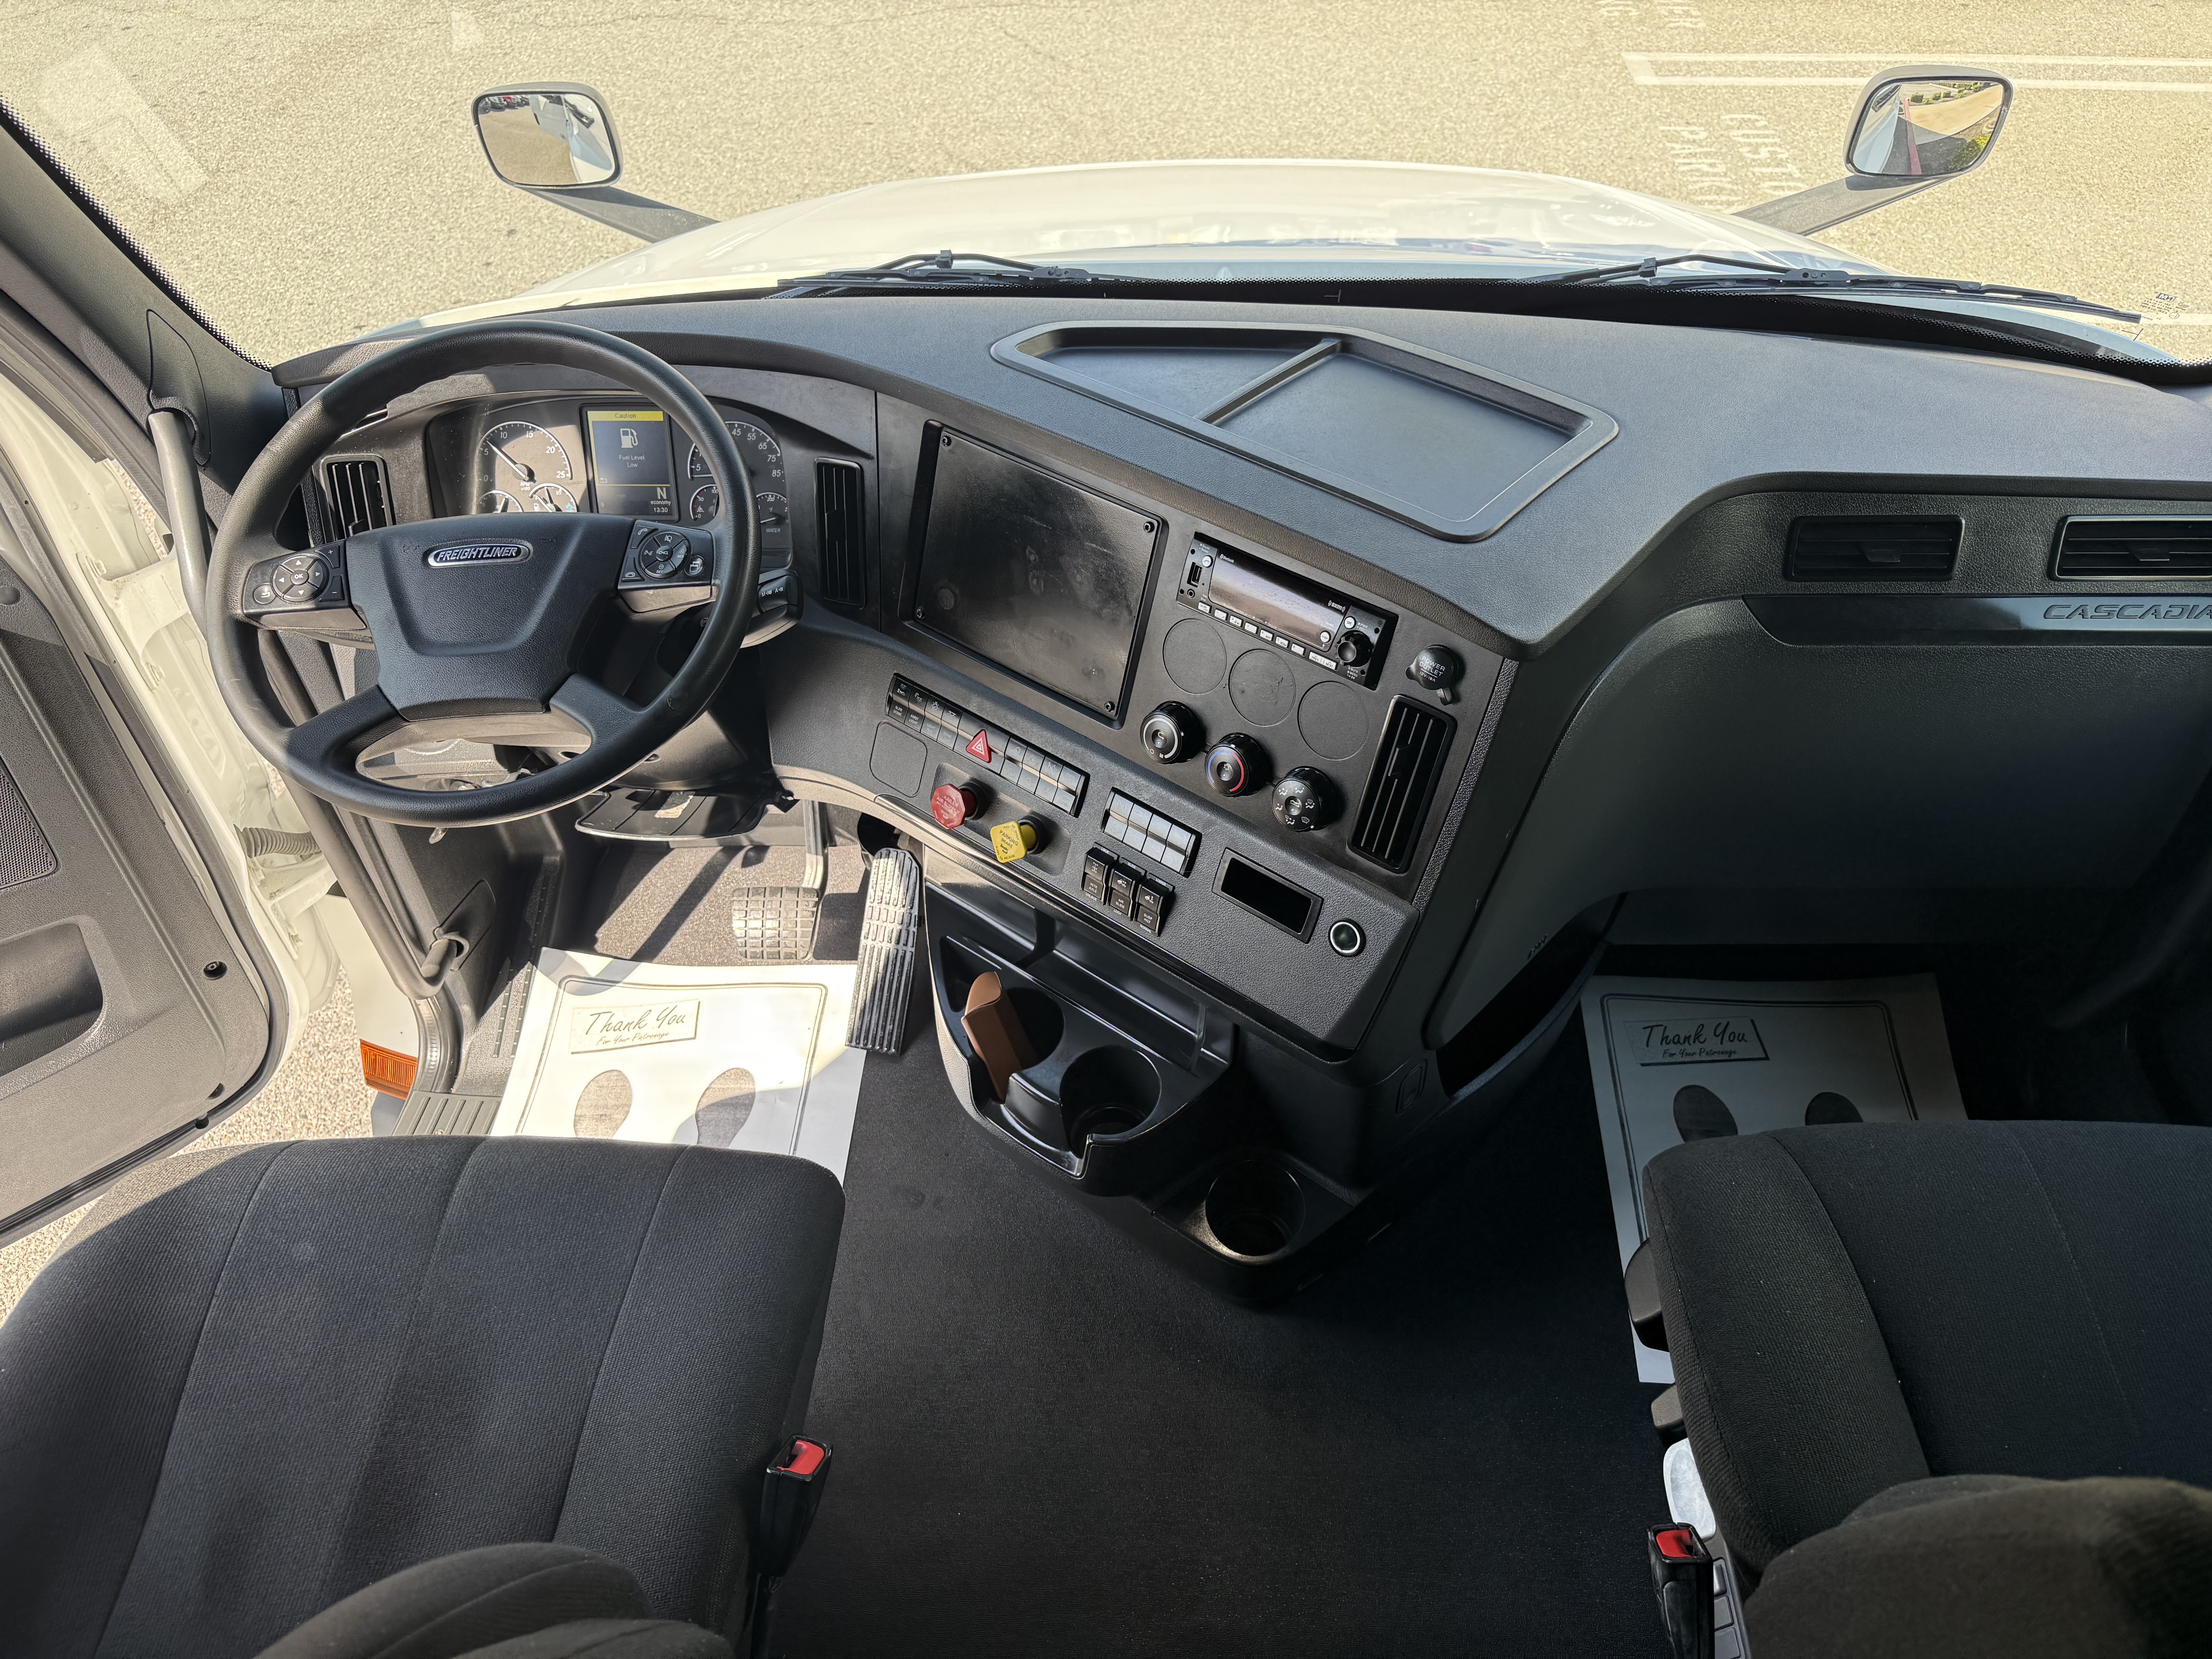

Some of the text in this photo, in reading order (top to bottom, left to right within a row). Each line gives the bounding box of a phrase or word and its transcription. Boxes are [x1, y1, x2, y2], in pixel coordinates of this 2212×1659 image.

[657, 487, 667, 499] N
[437, 547, 517, 562] FREIGHTLINER
[2044, 605, 2212, 619] CASCADIA
[1419, 661, 1443, 676] OUTLET
[1422, 656, 1445, 671] POWER
[1420, 671, 1436, 682] 12V-10A
[941, 796, 958, 808] RAILER
[944, 801, 960, 815] SUPPLY
[1000, 830, 1018, 846] PARKING
[1001, 838, 1013, 848] BRAKE
[1085, 893, 1097, 901] UNLOCK
[585, 1005, 686, 1035] Thank You
[596, 1037, 611, 1046] For
[614, 1035, 630, 1044] Your
[1643, 1021, 1748, 1047] Thank You
[1662, 1049, 1738, 1058] For Your Patronage
